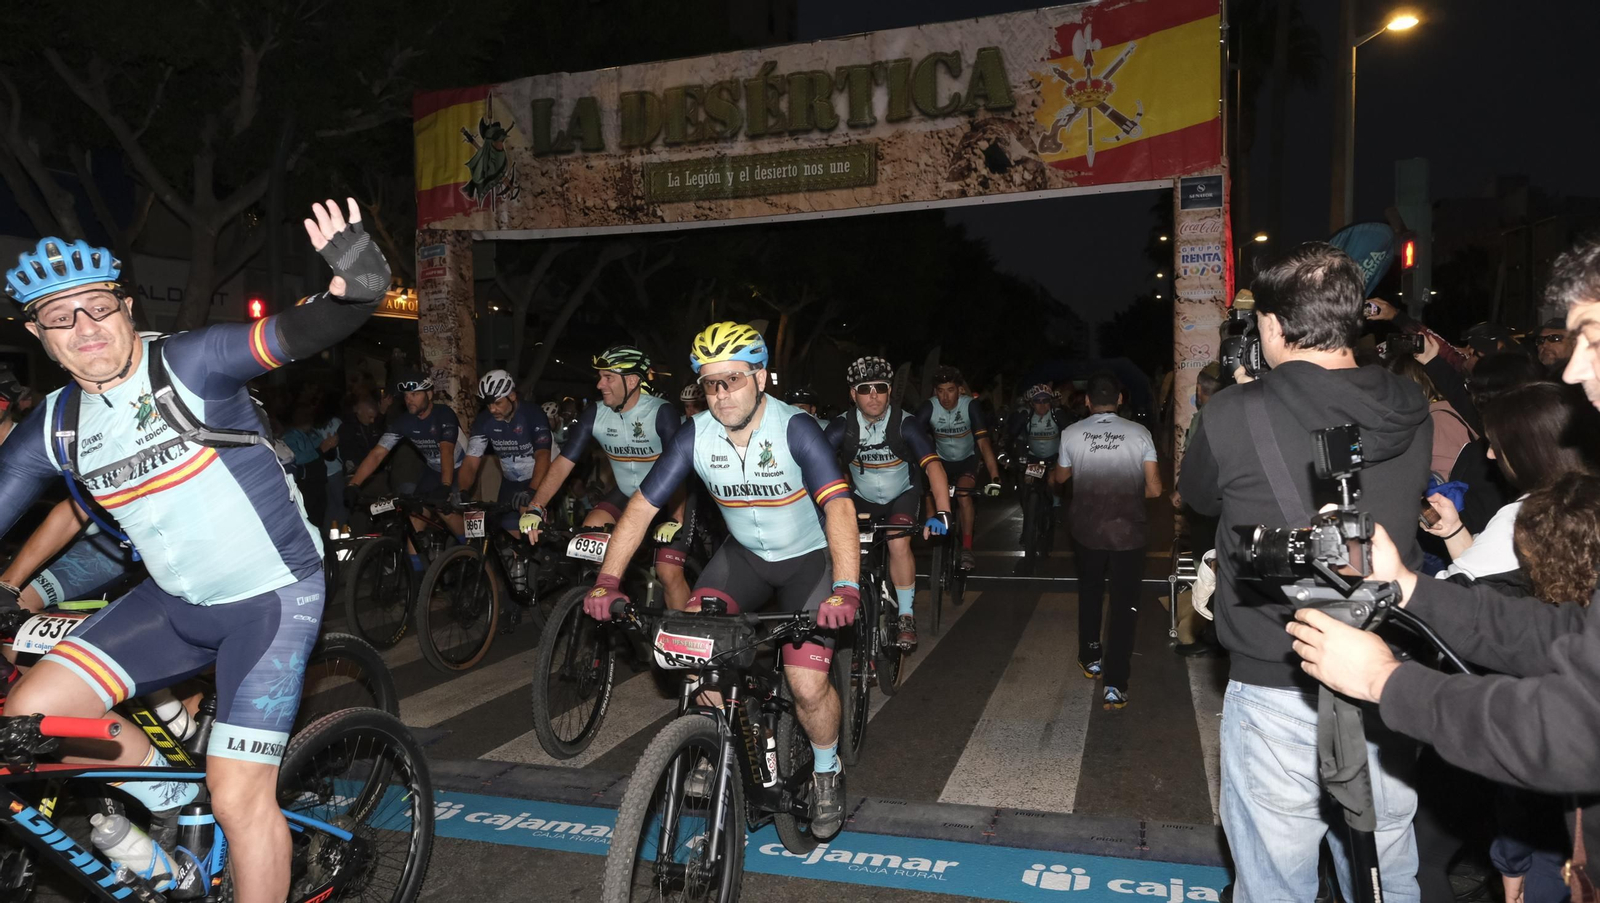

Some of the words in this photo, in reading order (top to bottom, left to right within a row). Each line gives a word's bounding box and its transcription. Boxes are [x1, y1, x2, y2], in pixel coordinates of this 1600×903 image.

[531, 96, 604, 157] LA
[619, 46, 1016, 149] DESÉRTICA
[667, 172, 679, 188] La
[685, 169, 721, 188] Legión
[727, 171, 733, 185] y
[739, 166, 750, 182] el
[754, 162, 798, 181] desierto
[803, 163, 824, 176] nos
[829, 160, 851, 173] une
[1182, 245, 1220, 253] GRUPO
[1181, 253, 1221, 264] RENTA
[136, 438, 145, 446] VI
[1083, 431, 1103, 442] Pepe
[1103, 431, 1125, 442] Yepes
[604, 444, 613, 454] LA
[613, 444, 655, 456] DESÉRTICA
[1090, 441, 1119, 453] Speaker
[761, 470, 784, 478] EDICIÓN
[708, 481, 721, 497] LA
[722, 480, 793, 497] DESÉRTICA
[575, 538, 604, 556] 6936
[28, 617, 79, 640] 7537
[226, 737, 246, 752] LA
[532, 830, 567, 841] CAJA
[848, 864, 888, 875] CAJA
[894, 868, 948, 881] RURAL
